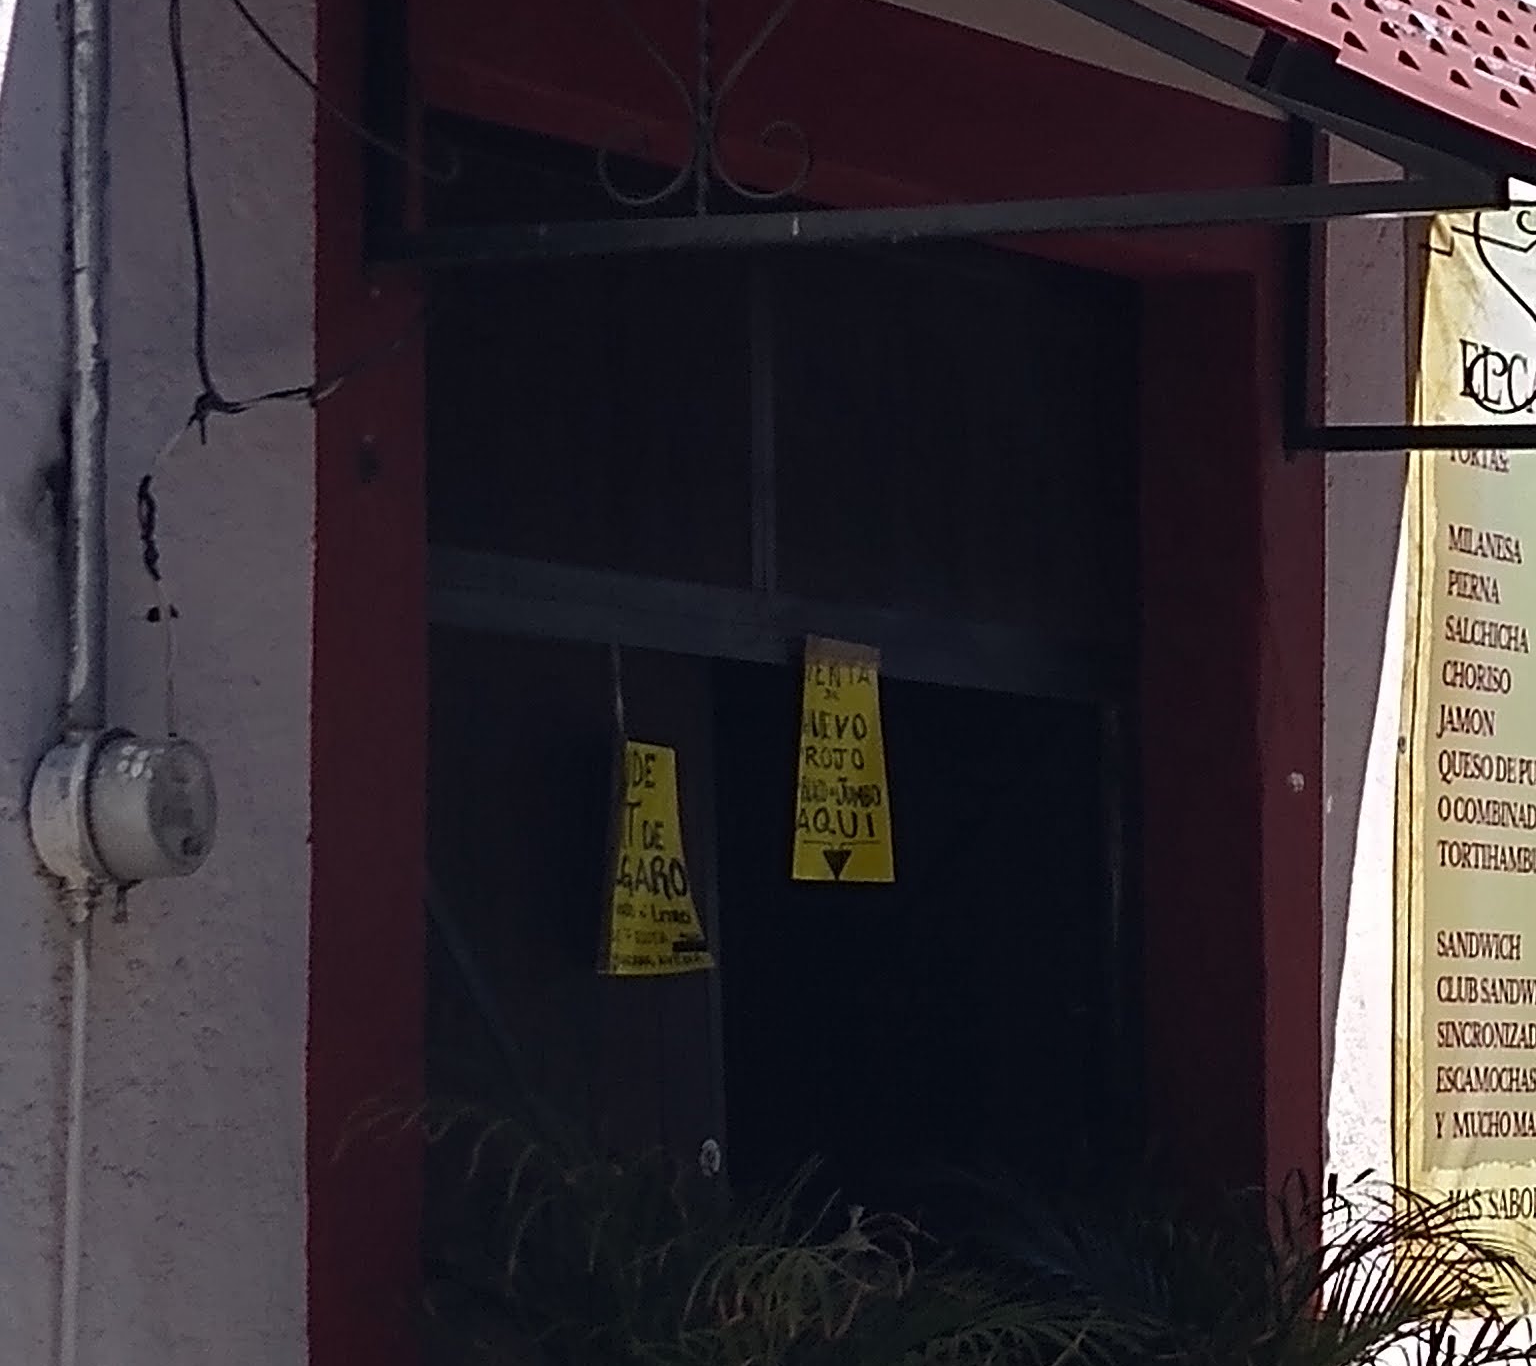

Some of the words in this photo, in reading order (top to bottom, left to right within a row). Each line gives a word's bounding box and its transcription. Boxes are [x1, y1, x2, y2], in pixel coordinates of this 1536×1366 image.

[1448, 524, 1523, 564] MILANESA
[1447, 569, 1501, 604] PIERNA
[1445, 614, 1530, 653] SALCHICHA
[1442, 660, 1512, 694] CHORISO
[1436, 704, 1496, 738] JAMON
[805, 745, 865, 770] ROJO
[1438, 750, 1493, 784] QUESO
[1496, 756, 1517, 784] DE
[798, 806, 876, 839] AQUI
[1438, 795, 1451, 822] O
[1437, 930, 1521, 961] SANDWICH
[1437, 976, 1478, 1003] CLUB
[1435, 1112, 1446, 1139] Y
[1453, 1111, 1511, 1138] MUCHO
